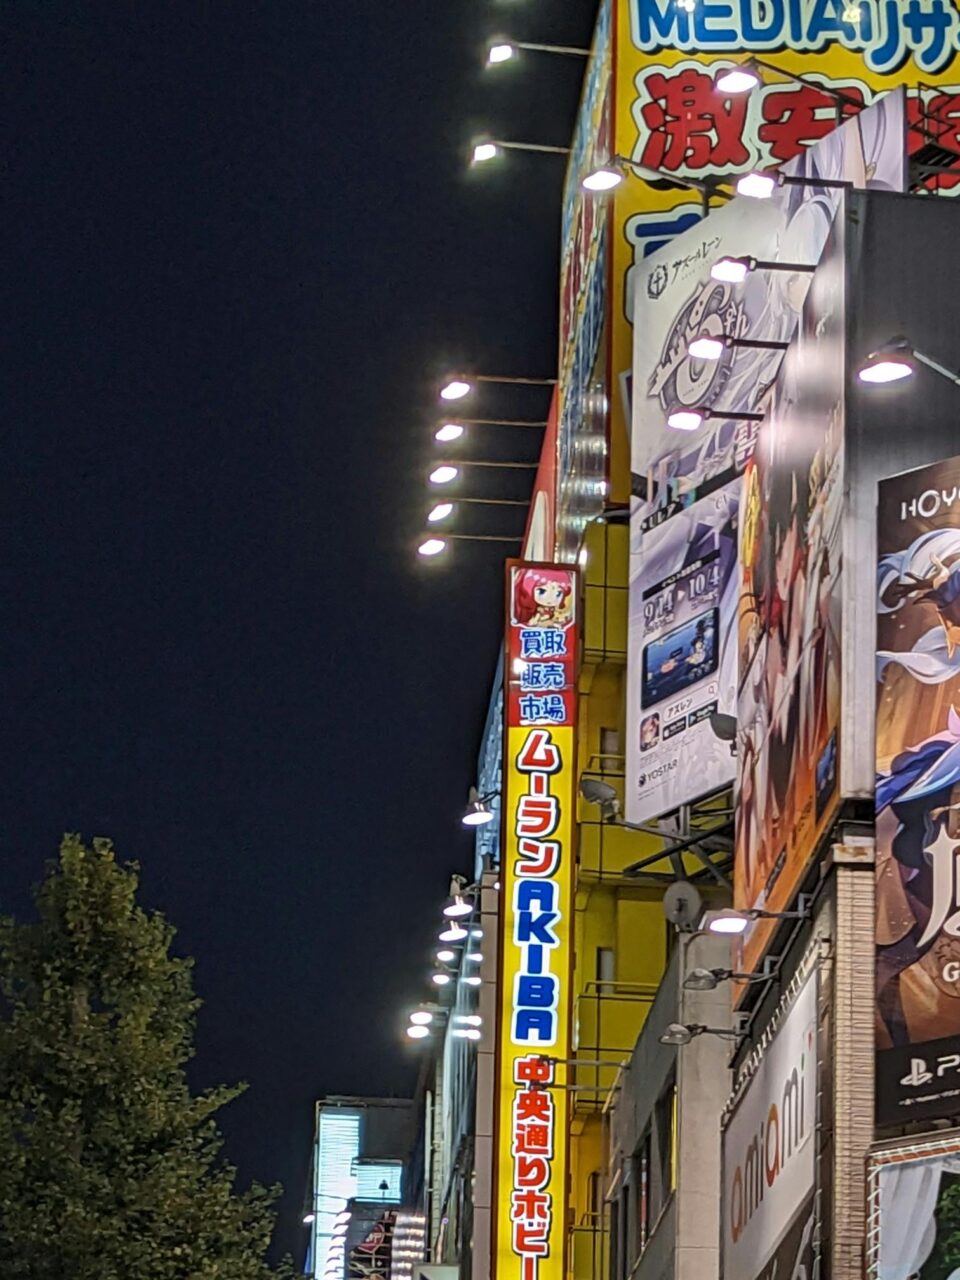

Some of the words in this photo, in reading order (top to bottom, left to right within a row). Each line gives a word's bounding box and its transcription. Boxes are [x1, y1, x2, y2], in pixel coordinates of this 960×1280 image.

[521, 630, 566, 655] 買取
[521, 663, 566, 687] 販売
[520, 695, 565, 720] 市場
